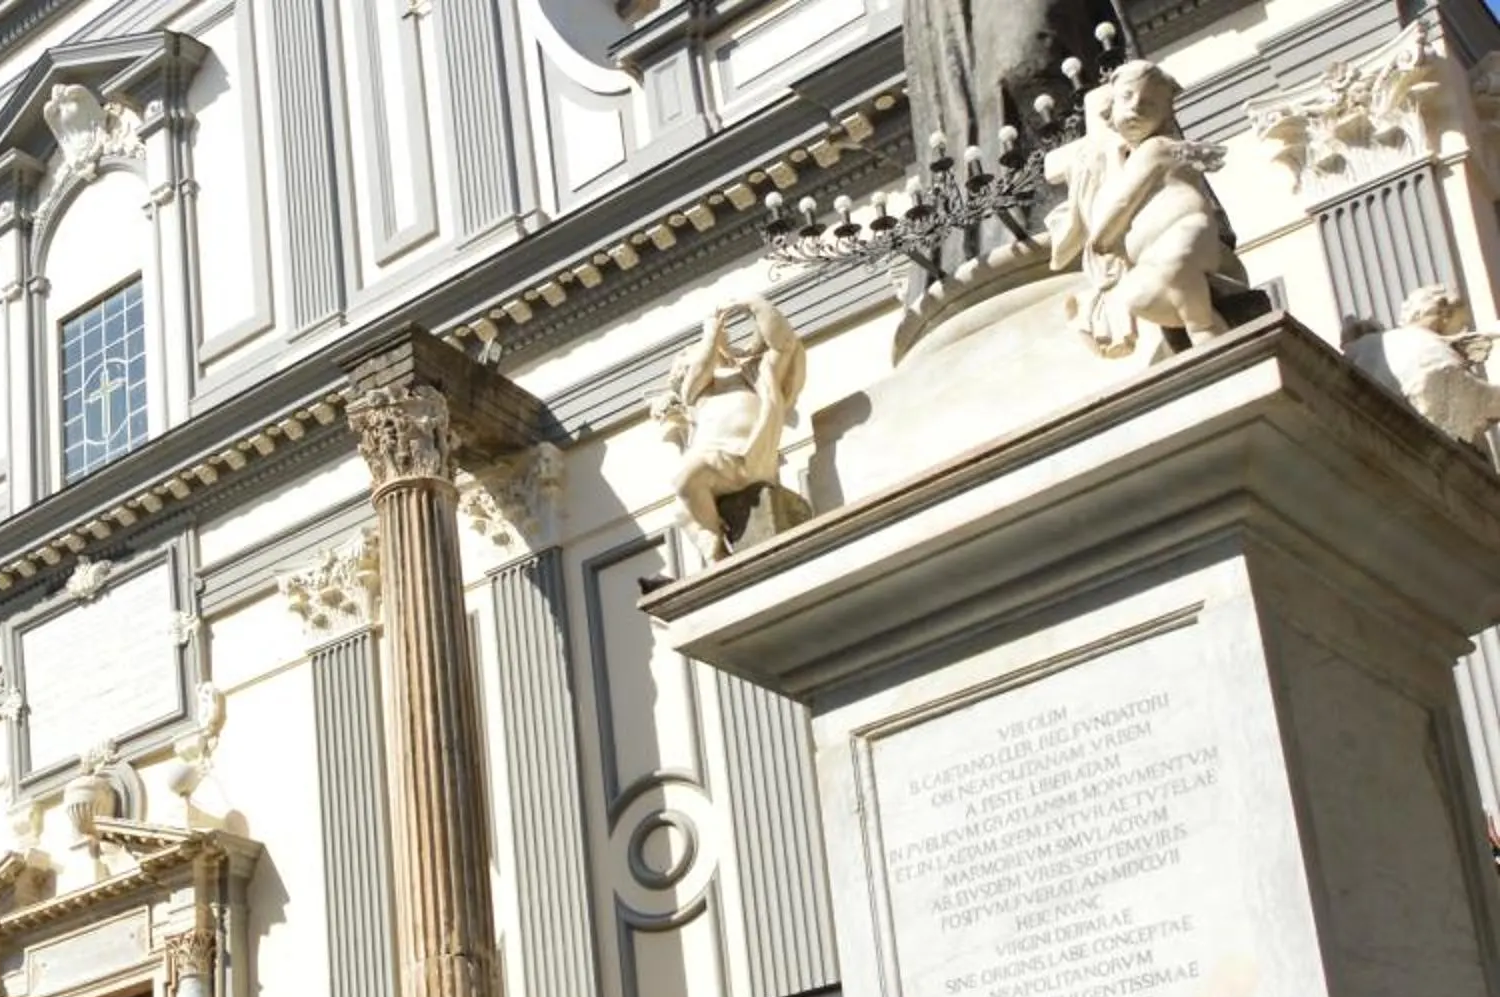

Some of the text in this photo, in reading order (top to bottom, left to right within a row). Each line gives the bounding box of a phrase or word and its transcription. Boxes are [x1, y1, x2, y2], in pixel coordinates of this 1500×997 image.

[1070, 690, 1171, 739] FVNDATORI
[956, 742, 1087, 800] NEAPOLITANAM
[1090, 718, 1153, 755] VRBEM
[1027, 751, 1122, 798] LIBERATAM
[1080, 742, 1219, 802] MONVMENTVM
[1131, 765, 1220, 809] TVTELAE
[940, 803, 1170, 891] MARMOREVM SIMVLACRVM
[1072, 820, 1190, 873] SEPTEMVIRIS
[1053, 890, 1105, 922] NVNC
[943, 909, 1196, 996] SINE ORIGINIS LABE CONCEPTAE
[994, 928, 1053, 960] VIRGINI
